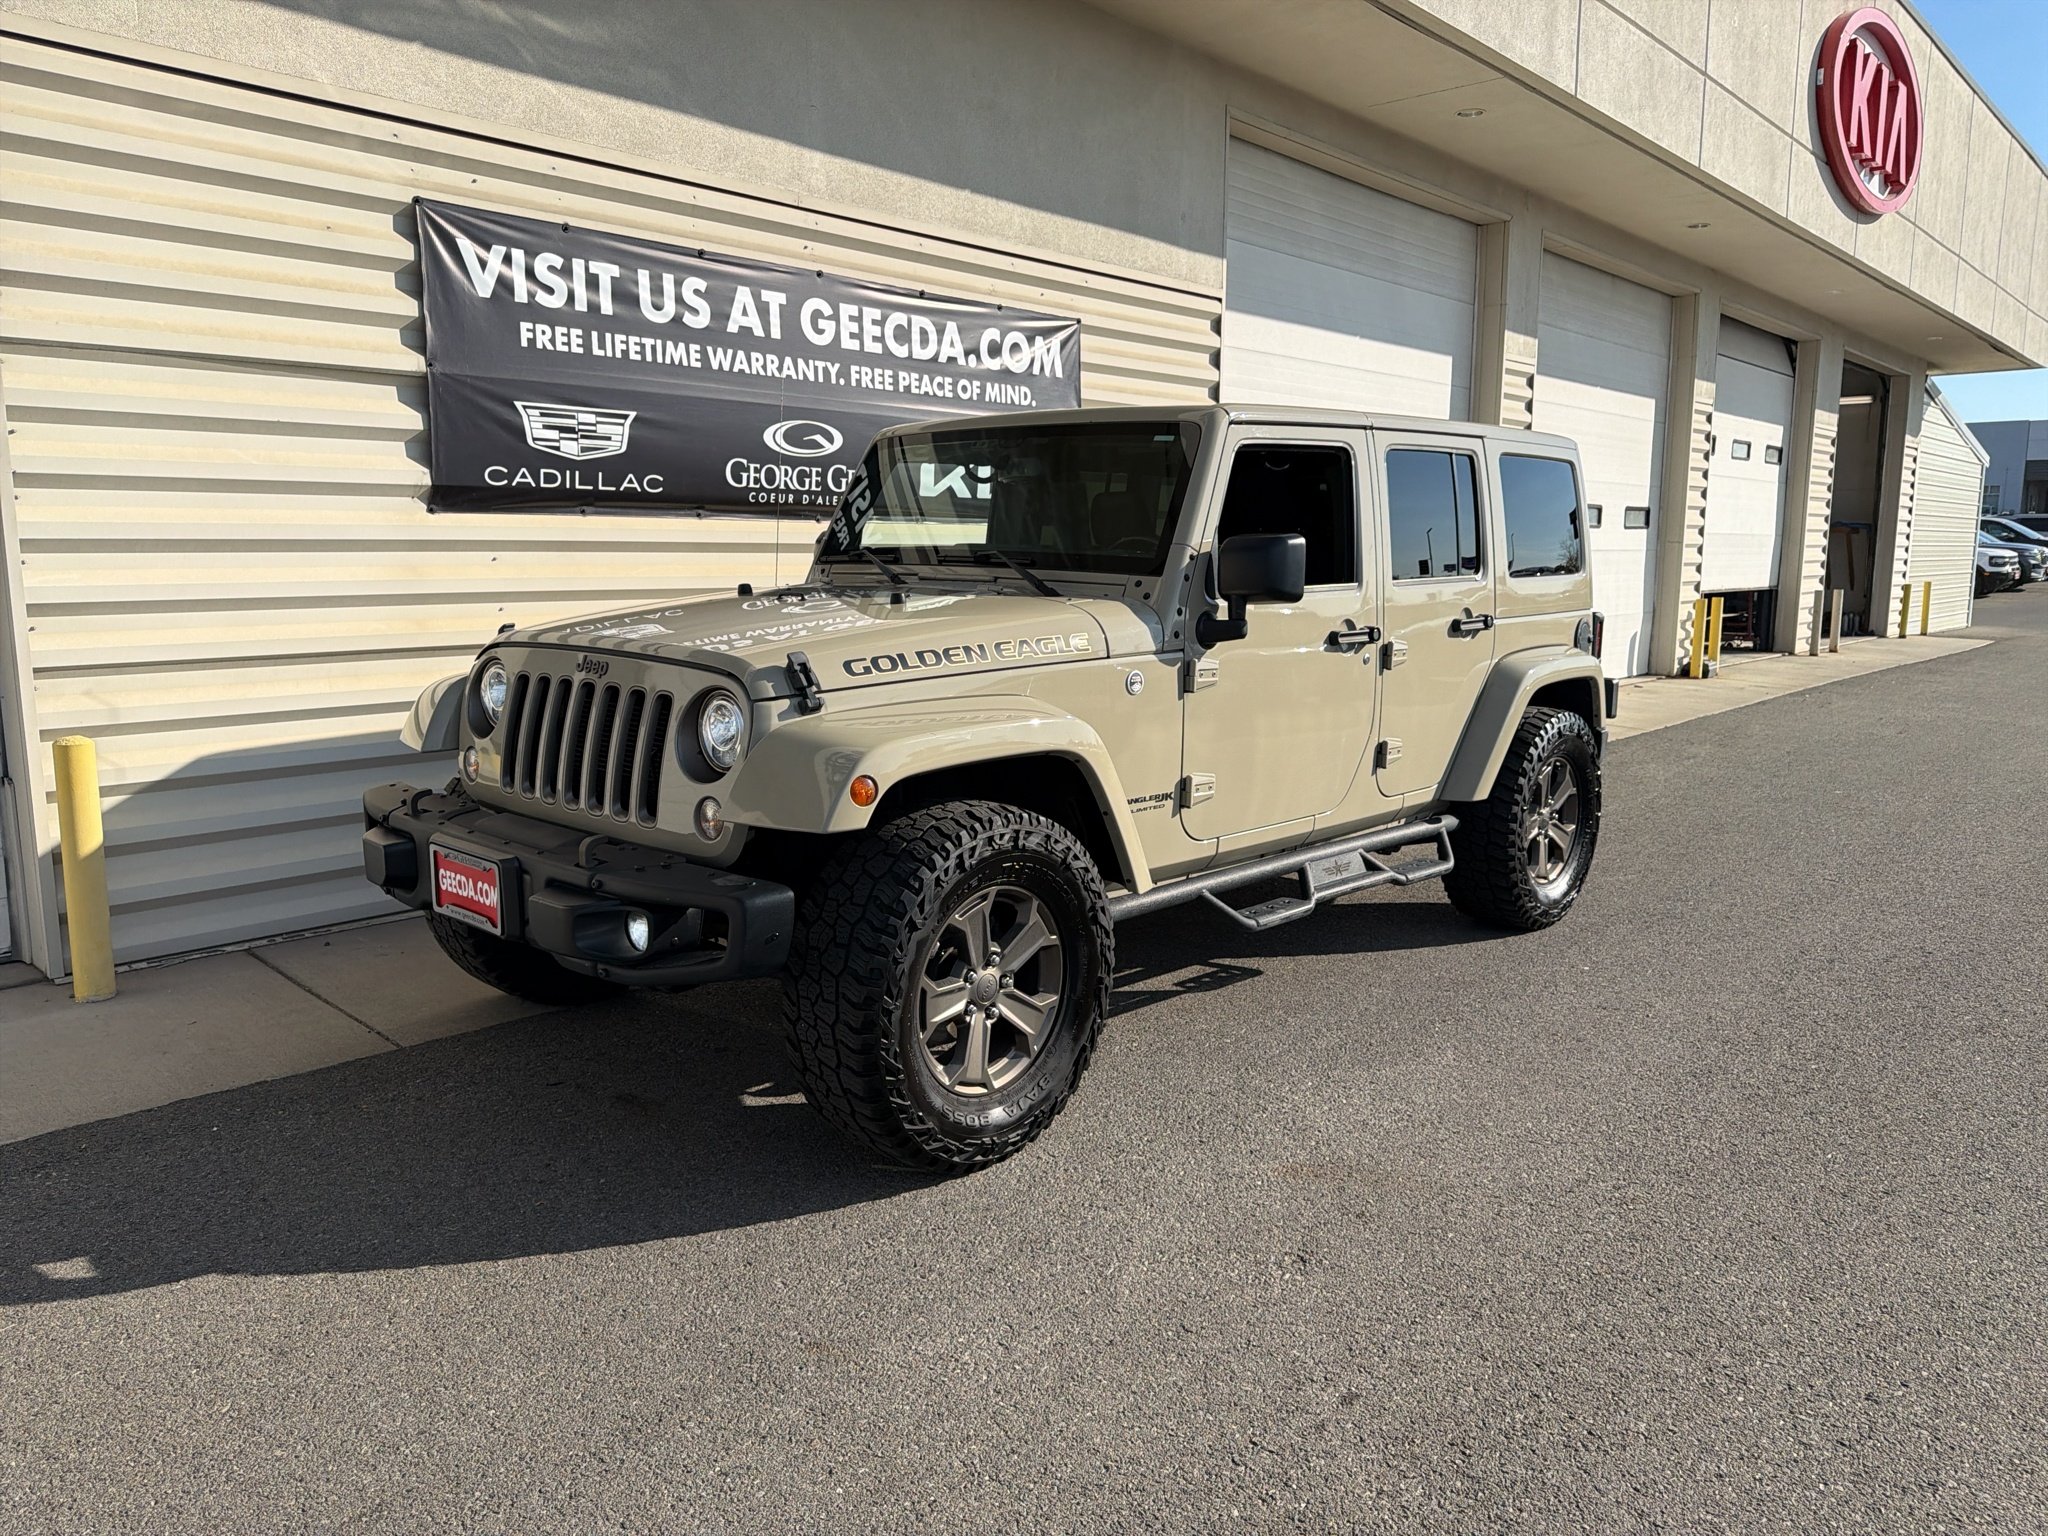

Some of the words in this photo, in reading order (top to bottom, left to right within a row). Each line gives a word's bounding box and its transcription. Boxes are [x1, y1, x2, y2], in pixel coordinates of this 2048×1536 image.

[1850, 36, 1907, 186] KIA
[455, 237, 620, 315] VISIT
[637, 269, 711, 329] US
[727, 285, 786, 339] AT
[800, 297, 1063, 378] GEECDA.COM
[520, 321, 584, 353] FREE
[592, 330, 701, 368] LIFETIME
[706, 345, 845, 386] WARRANTY.
[851, 365, 893, 391] FREE
[899, 371, 953, 398] PEACE
[957, 378, 981, 401] OF
[985, 382, 1037, 408] MIND.
[484, 466, 664, 493] CADILLAC
[725, 457, 822, 491] GEORGE
[749, 491, 794, 504] COEUR
[802, 493, 844, 506] D'ALE
[576, 655, 609, 678] Jeep
[842, 641, 990, 679] GOLDEN
[993, 633, 1092, 659] EAGLE
[439, 868, 497, 908] GEECDA.COM
[941, 1104, 993, 1128] BOSS
[1003, 1074, 1050, 1118] BAJA
